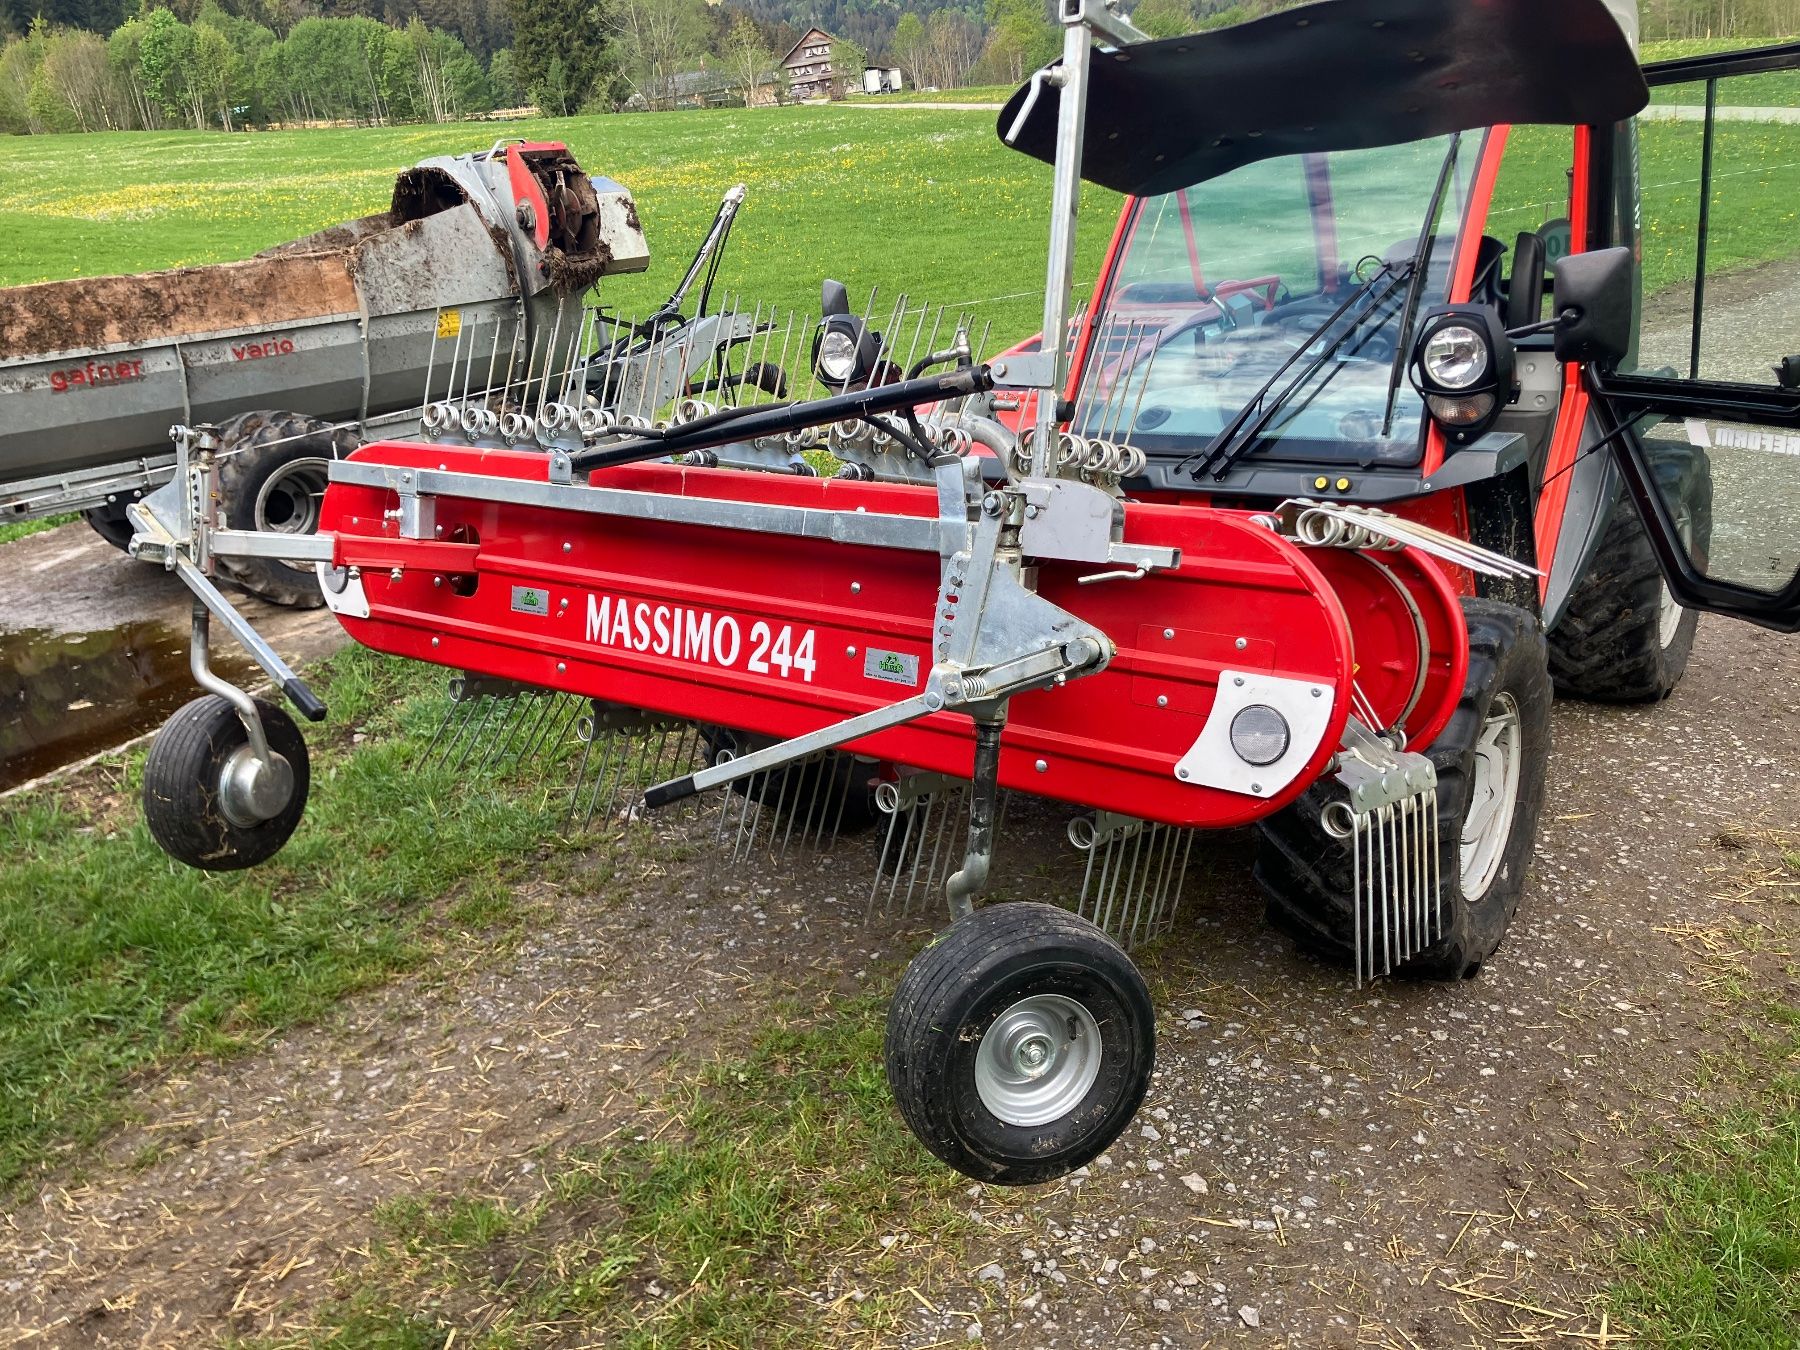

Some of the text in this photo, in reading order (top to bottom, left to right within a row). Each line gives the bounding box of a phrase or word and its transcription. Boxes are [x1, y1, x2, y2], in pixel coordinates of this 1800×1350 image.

[231, 337, 294, 361] vario
[50, 358, 144, 392] gafner
[585, 594, 817, 682] MASSIMO 244
